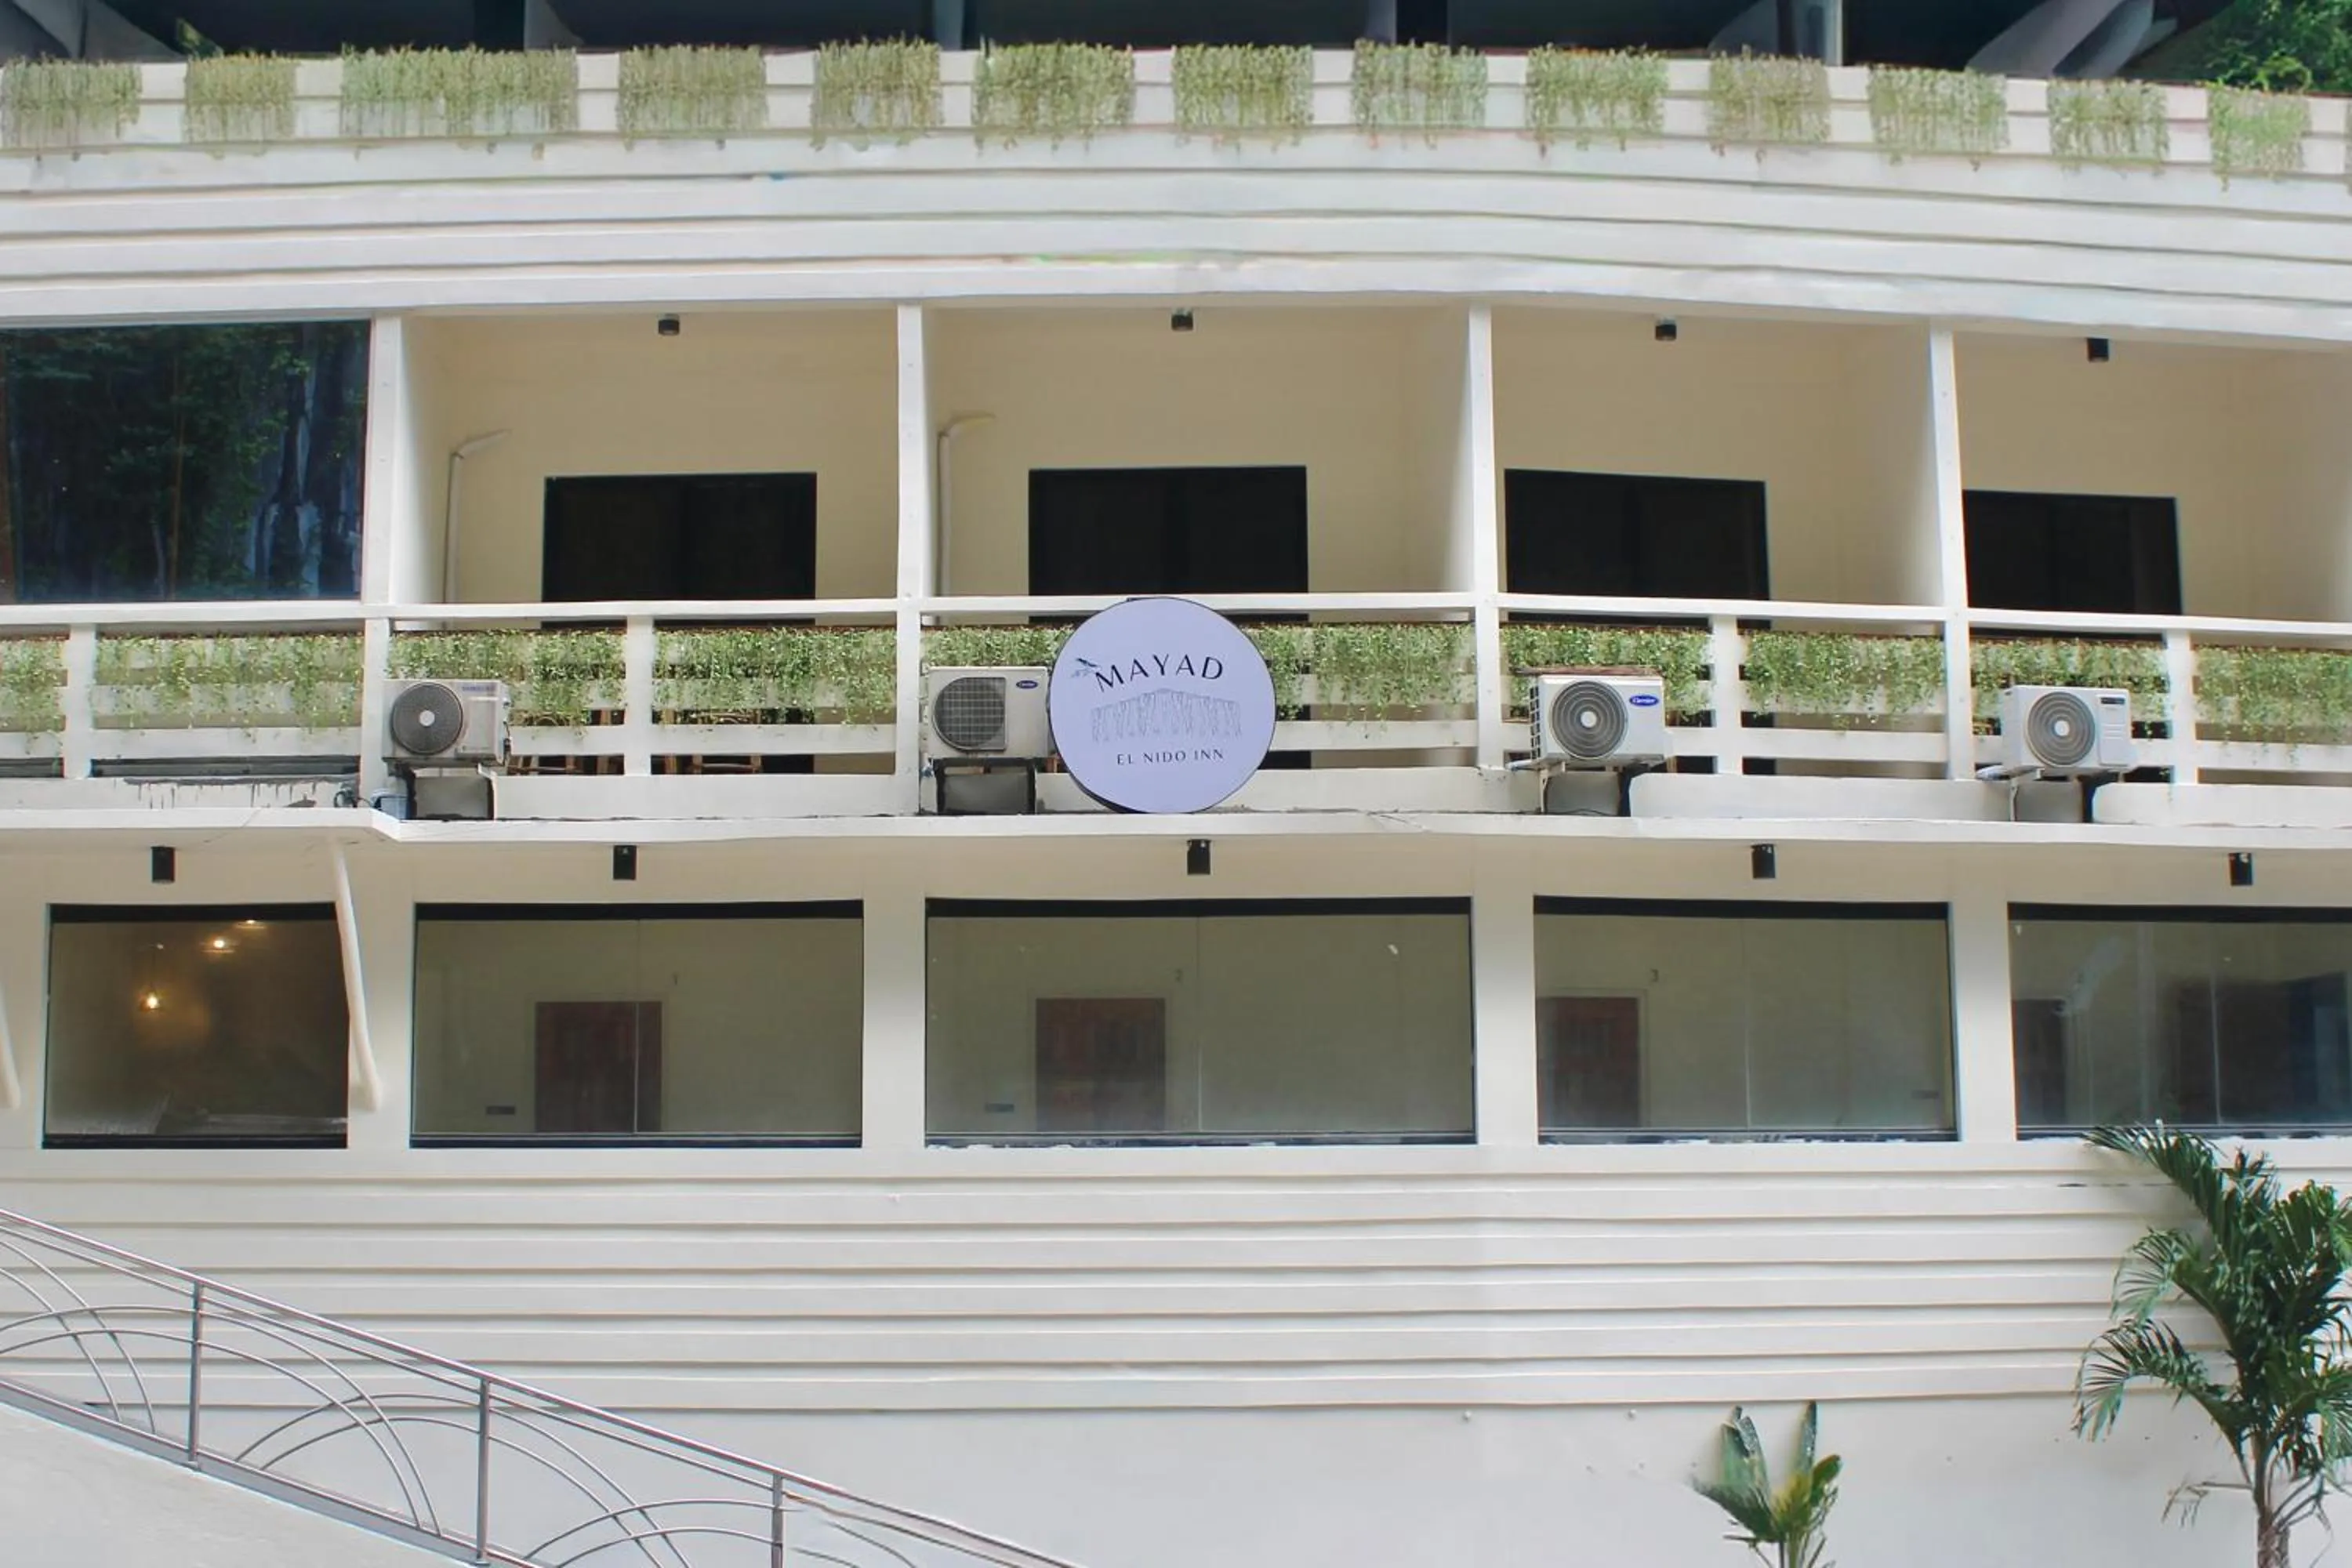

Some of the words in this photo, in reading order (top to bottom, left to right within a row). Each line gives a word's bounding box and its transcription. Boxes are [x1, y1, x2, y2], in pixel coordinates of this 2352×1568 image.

[1095, 654, 1223, 692] MAYAD
[1116, 753, 1133, 765] EL
[1143, 750, 1186, 764] NIDO
[1194, 749, 1224, 761] INN
